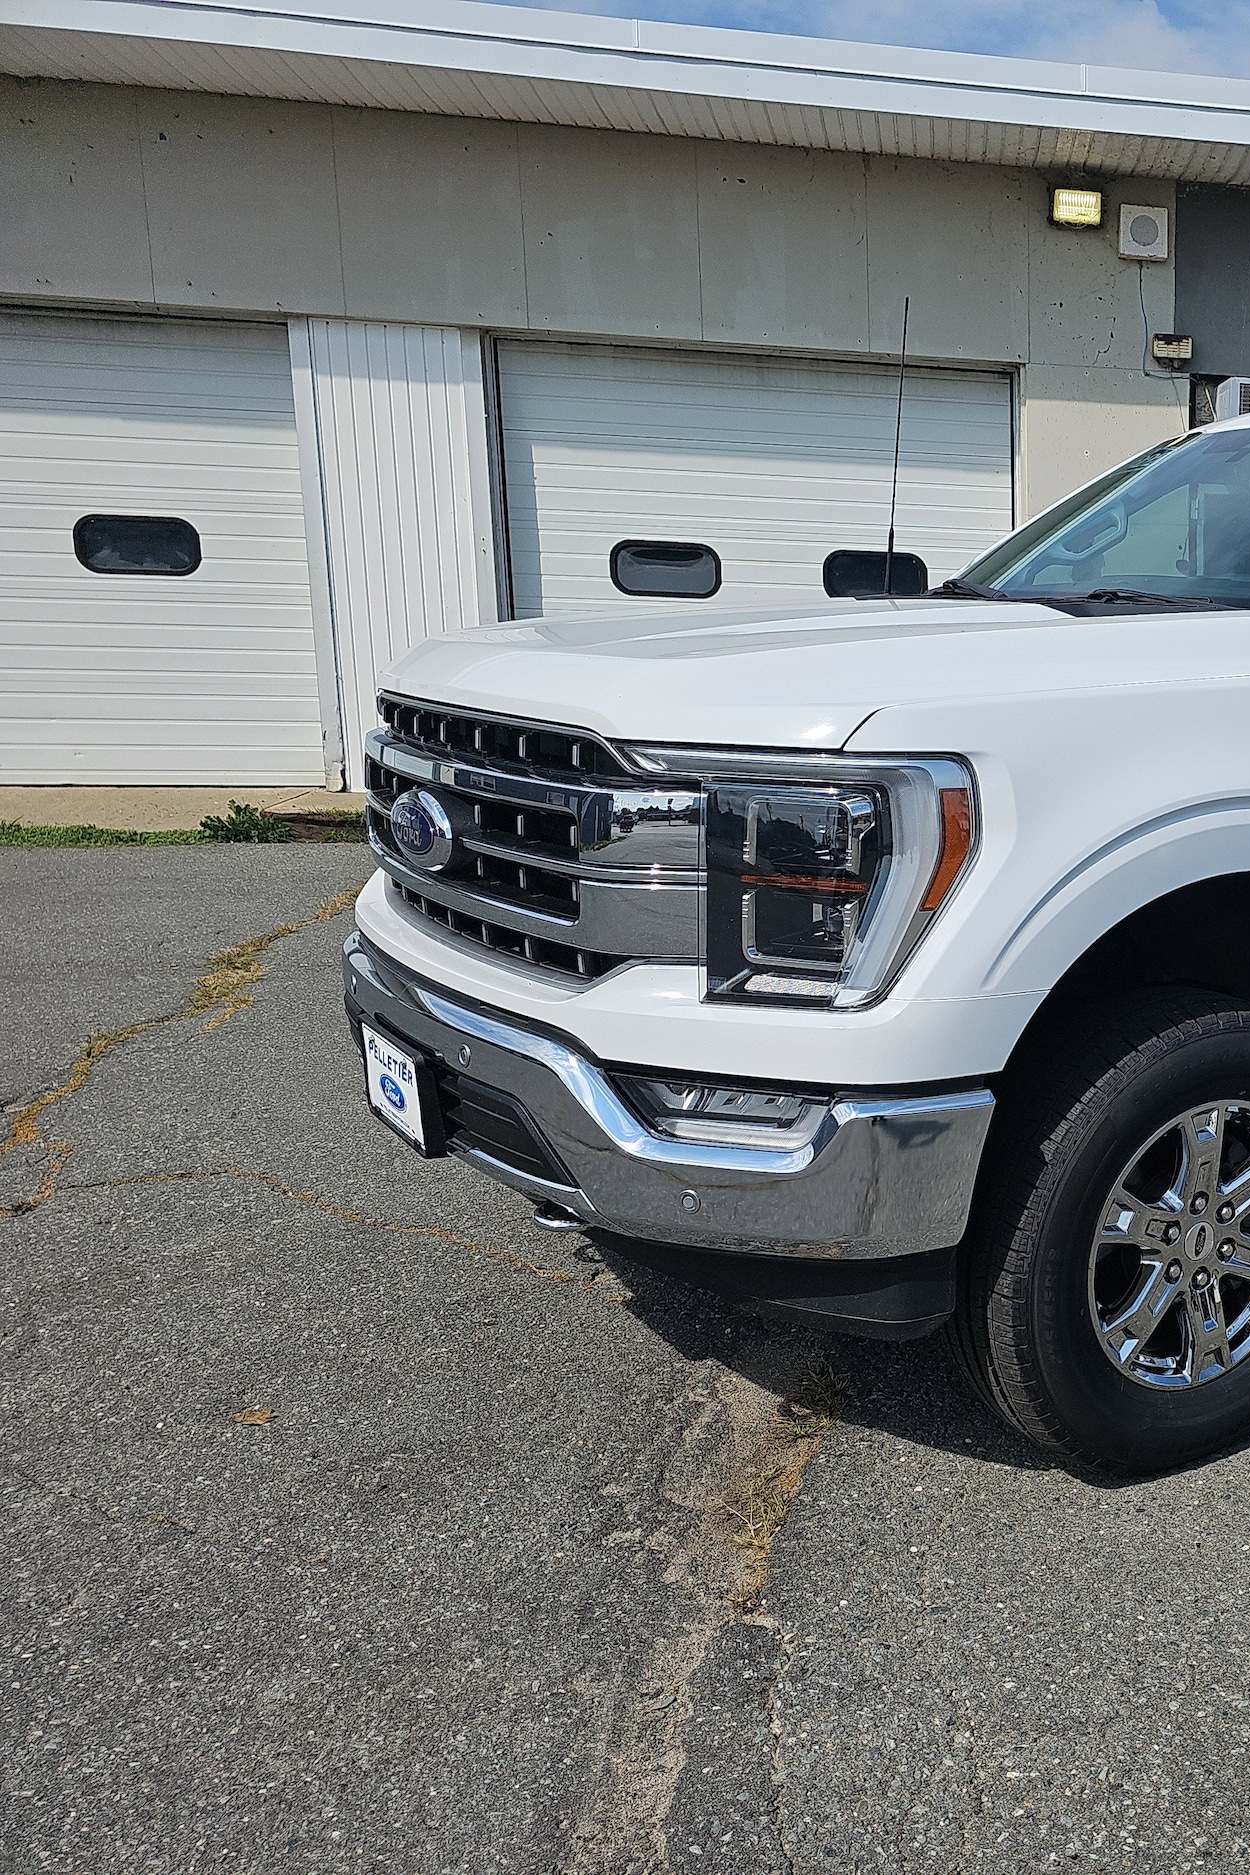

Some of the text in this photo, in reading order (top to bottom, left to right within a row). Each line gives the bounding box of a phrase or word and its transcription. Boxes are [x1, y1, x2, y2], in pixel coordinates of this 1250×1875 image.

[397, 810, 422, 846] Ford
[368, 1040, 414, 1087] PELLETIER
[384, 1079, 402, 1107] Ford
